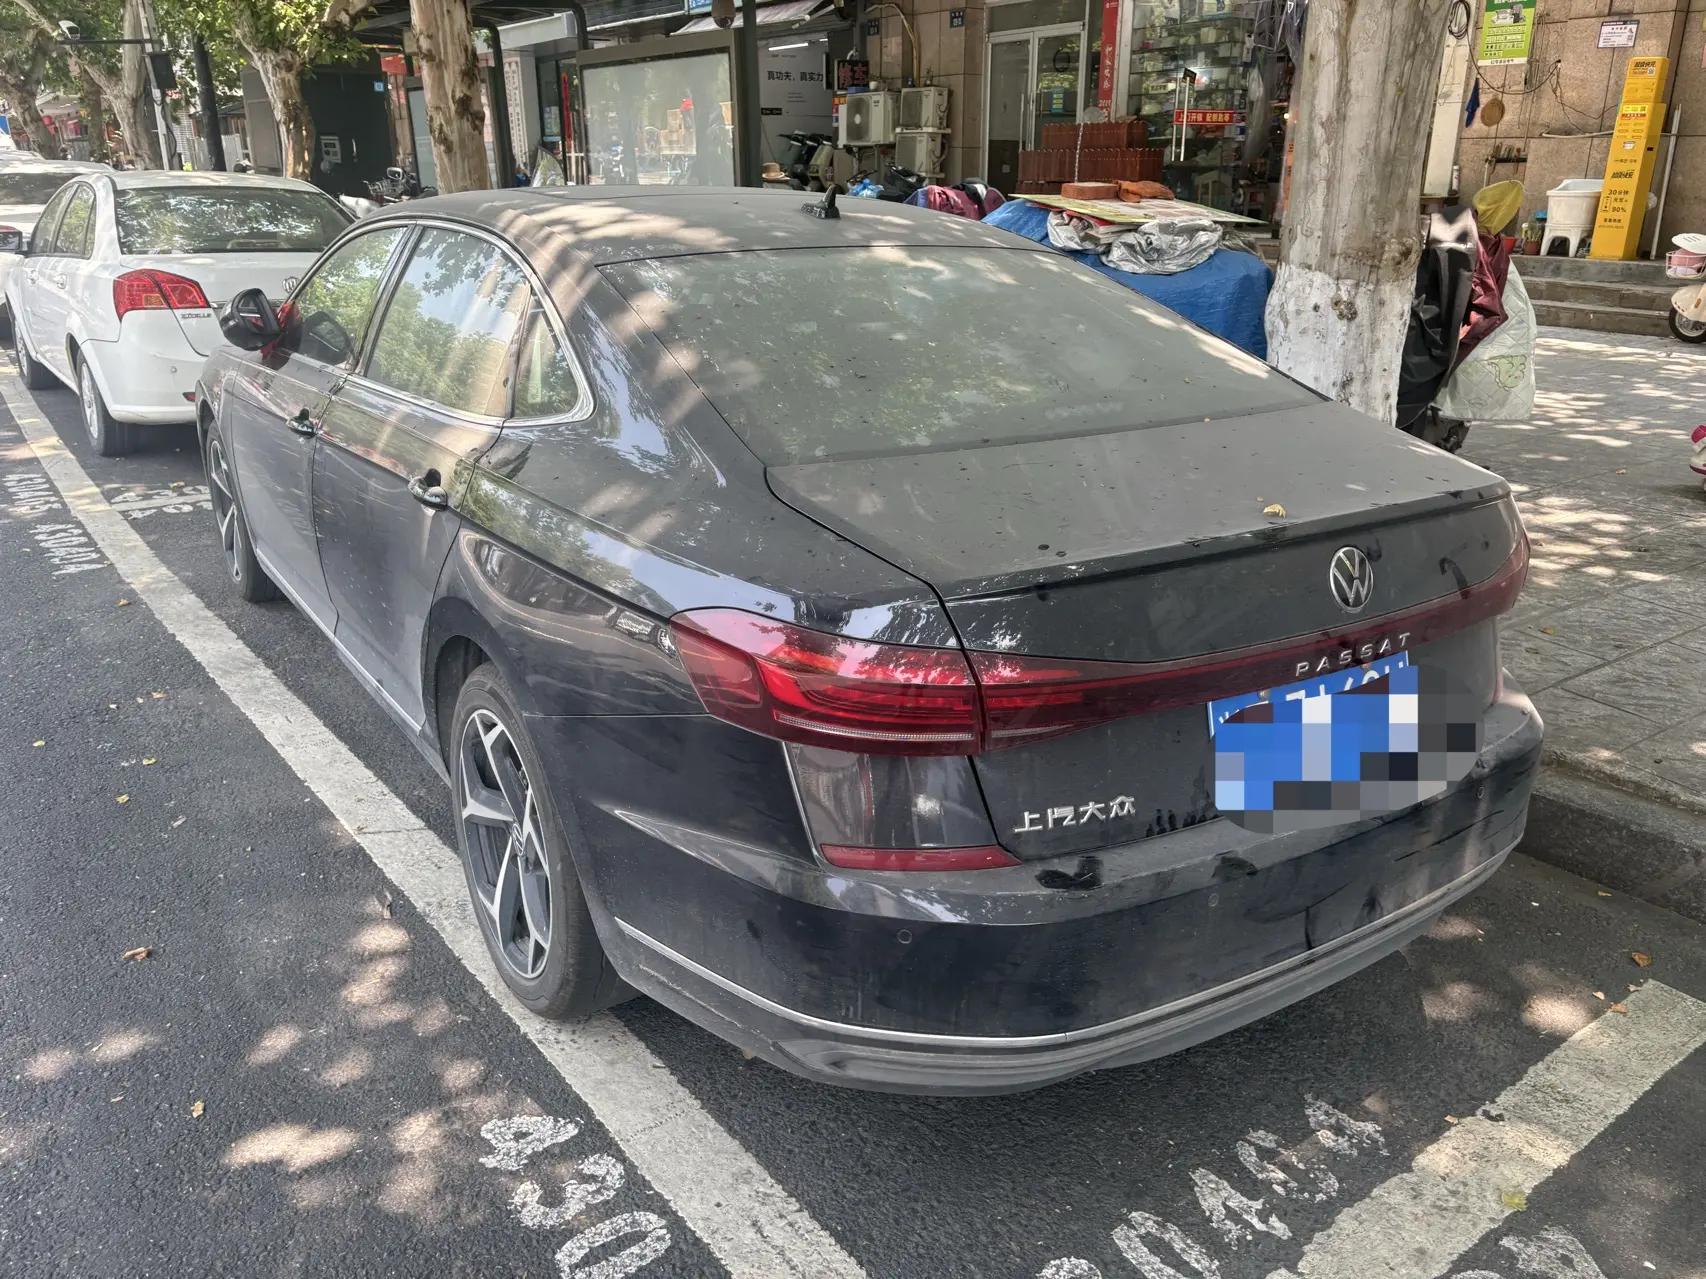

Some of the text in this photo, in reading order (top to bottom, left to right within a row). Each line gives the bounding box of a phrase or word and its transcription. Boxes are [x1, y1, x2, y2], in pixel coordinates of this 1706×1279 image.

[1295, 632, 1412, 677] PASSAT
[1014, 795, 1136, 832] 上汽大众
